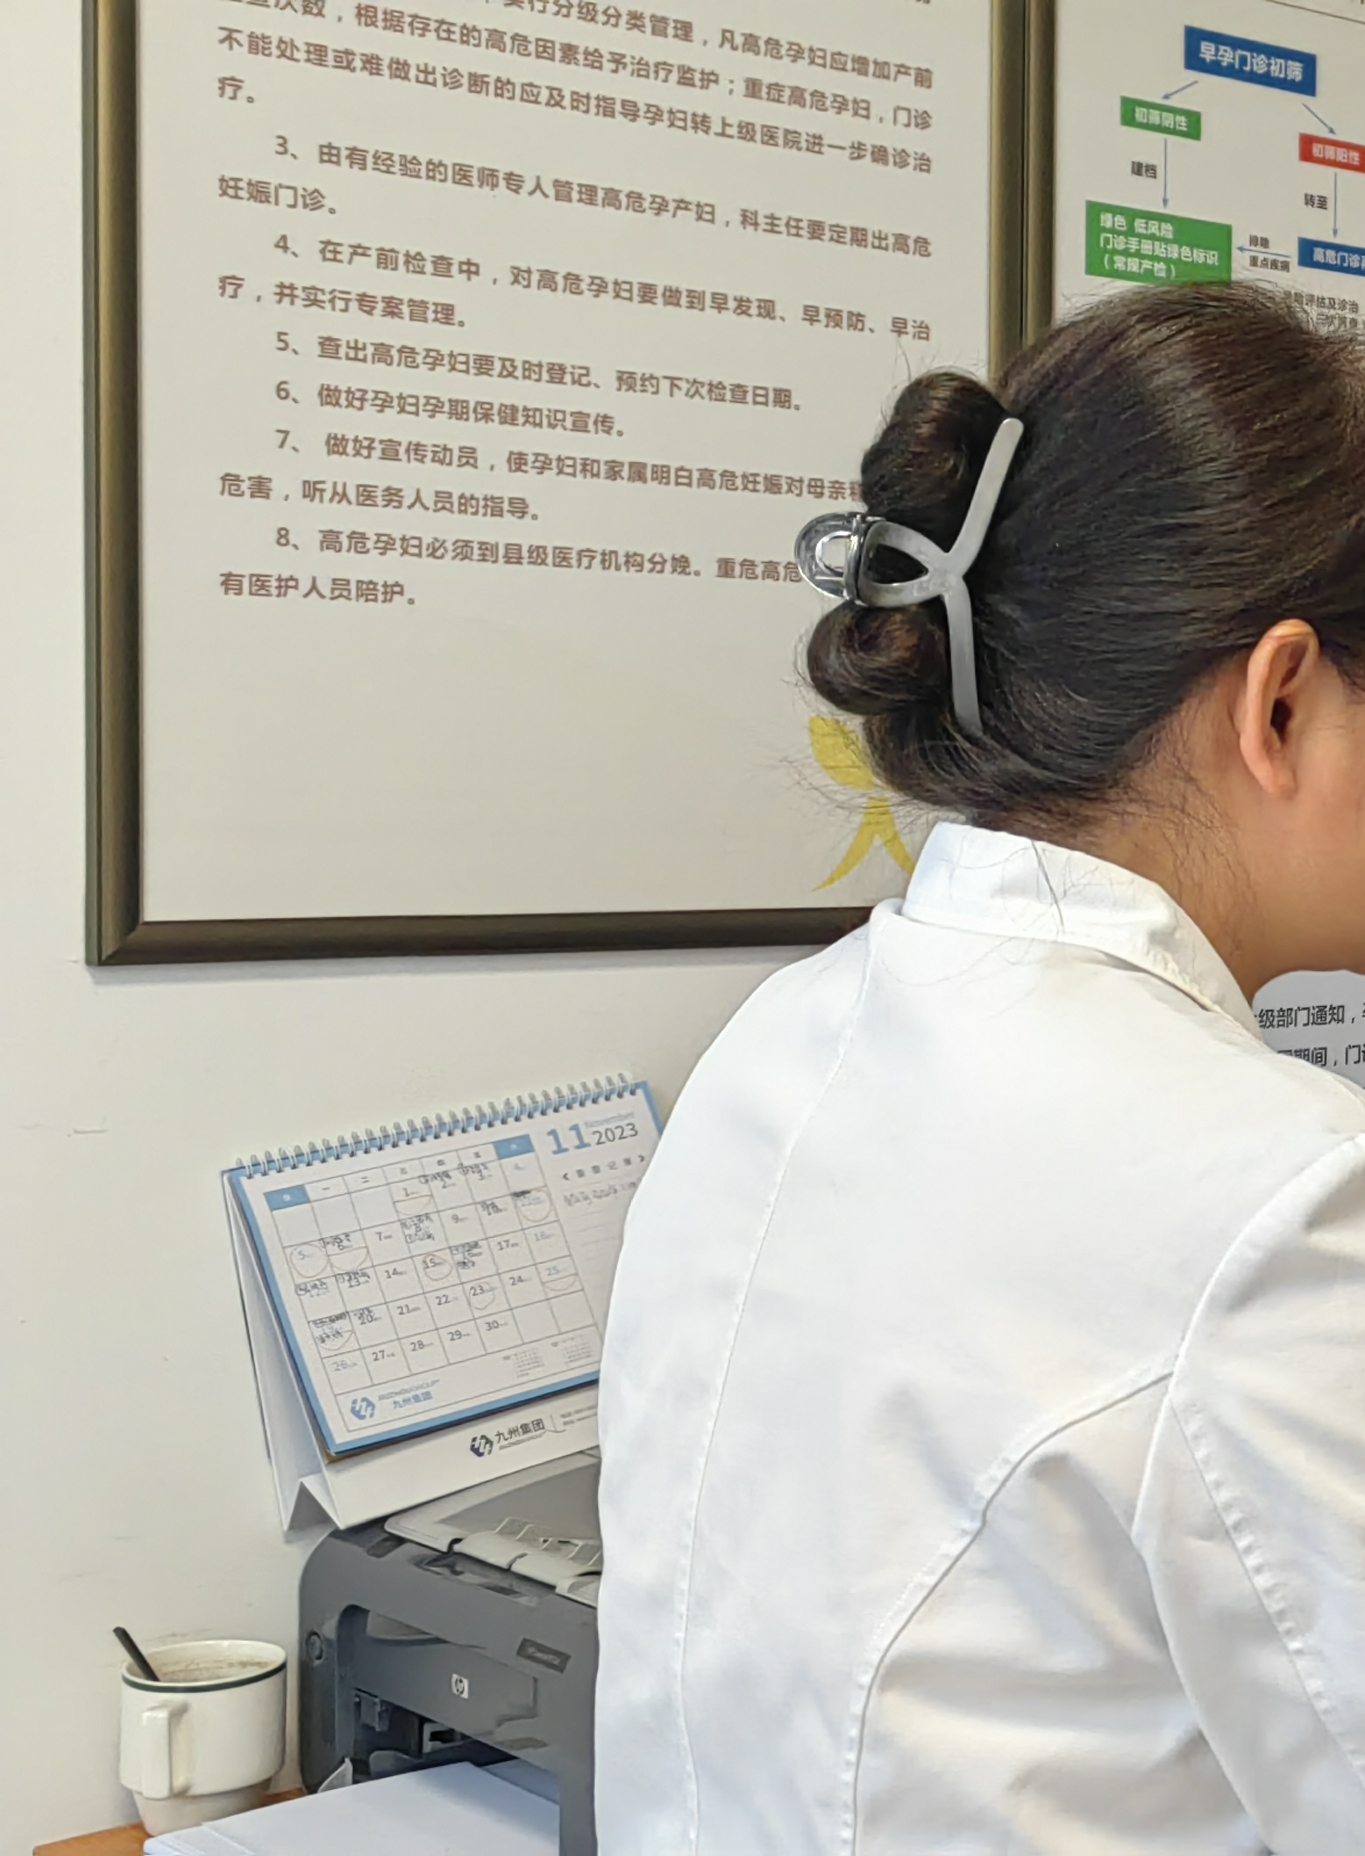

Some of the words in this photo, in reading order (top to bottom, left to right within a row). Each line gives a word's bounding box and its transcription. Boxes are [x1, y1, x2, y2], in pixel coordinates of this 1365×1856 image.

[485, 0, 933, 89] 行分级分类管理，凡高危孕妇应增加产前
[1199, 41, 1304, 82] 早孕门诊初筛
[227, 0, 932, 130] 次数，根据存在的高危因素给予治疗监护；重症高危孕妇，门诊
[218, 76, 255, 104] 疗。
[218, 26, 932, 174] 不能处理或难做出诊断的应及时指导孕妇转上级医院进一步确诊治
[1134, 106, 1188, 131] 初筛阴性
[1131, 160, 1157, 179] 建档
[1312, 142, 1360, 166] 初筛阳性
[218, 175, 338, 217] 妊娠门诊。
[1303, 192, 1328, 210] 转至
[1100, 212, 1127, 231] 绿色
[1134, 218, 1173, 239] 低风险
[1100, 233, 1219, 266] 门诊手册贴绿色标识
[218, 275, 467, 329] 疗，并实行专案管理。
[275, 331, 801, 411] 5、查出高危孕妇要及时登记、预约下次检查日期。
[275, 381, 626, 438] 6、做好孕妇孕期保健知识宣传。
[219, 472, 541, 521] 危害，听从医务人员的指导。
[219, 571, 416, 607] 有医护人员陪护。
[546, 1123, 592, 1155] 11
[592, 1122, 639, 1146] 2023
[375, 1232, 383, 1242] 7
[452, 1214, 459, 1224] 9
[384, 1268, 397, 1279] 14
[498, 1240, 510, 1251] 17
[435, 1295, 450, 1306] 22
[470, 1285, 485, 1297] 23
[509, 1276, 524, 1286] 24
[372, 1350, 385, 1361] 27
[410, 1340, 425, 1352] 28
[448, 1330, 462, 1341] 29
[485, 1320, 499, 1331] 30
[495, 1418, 546, 1444] 九州集团
